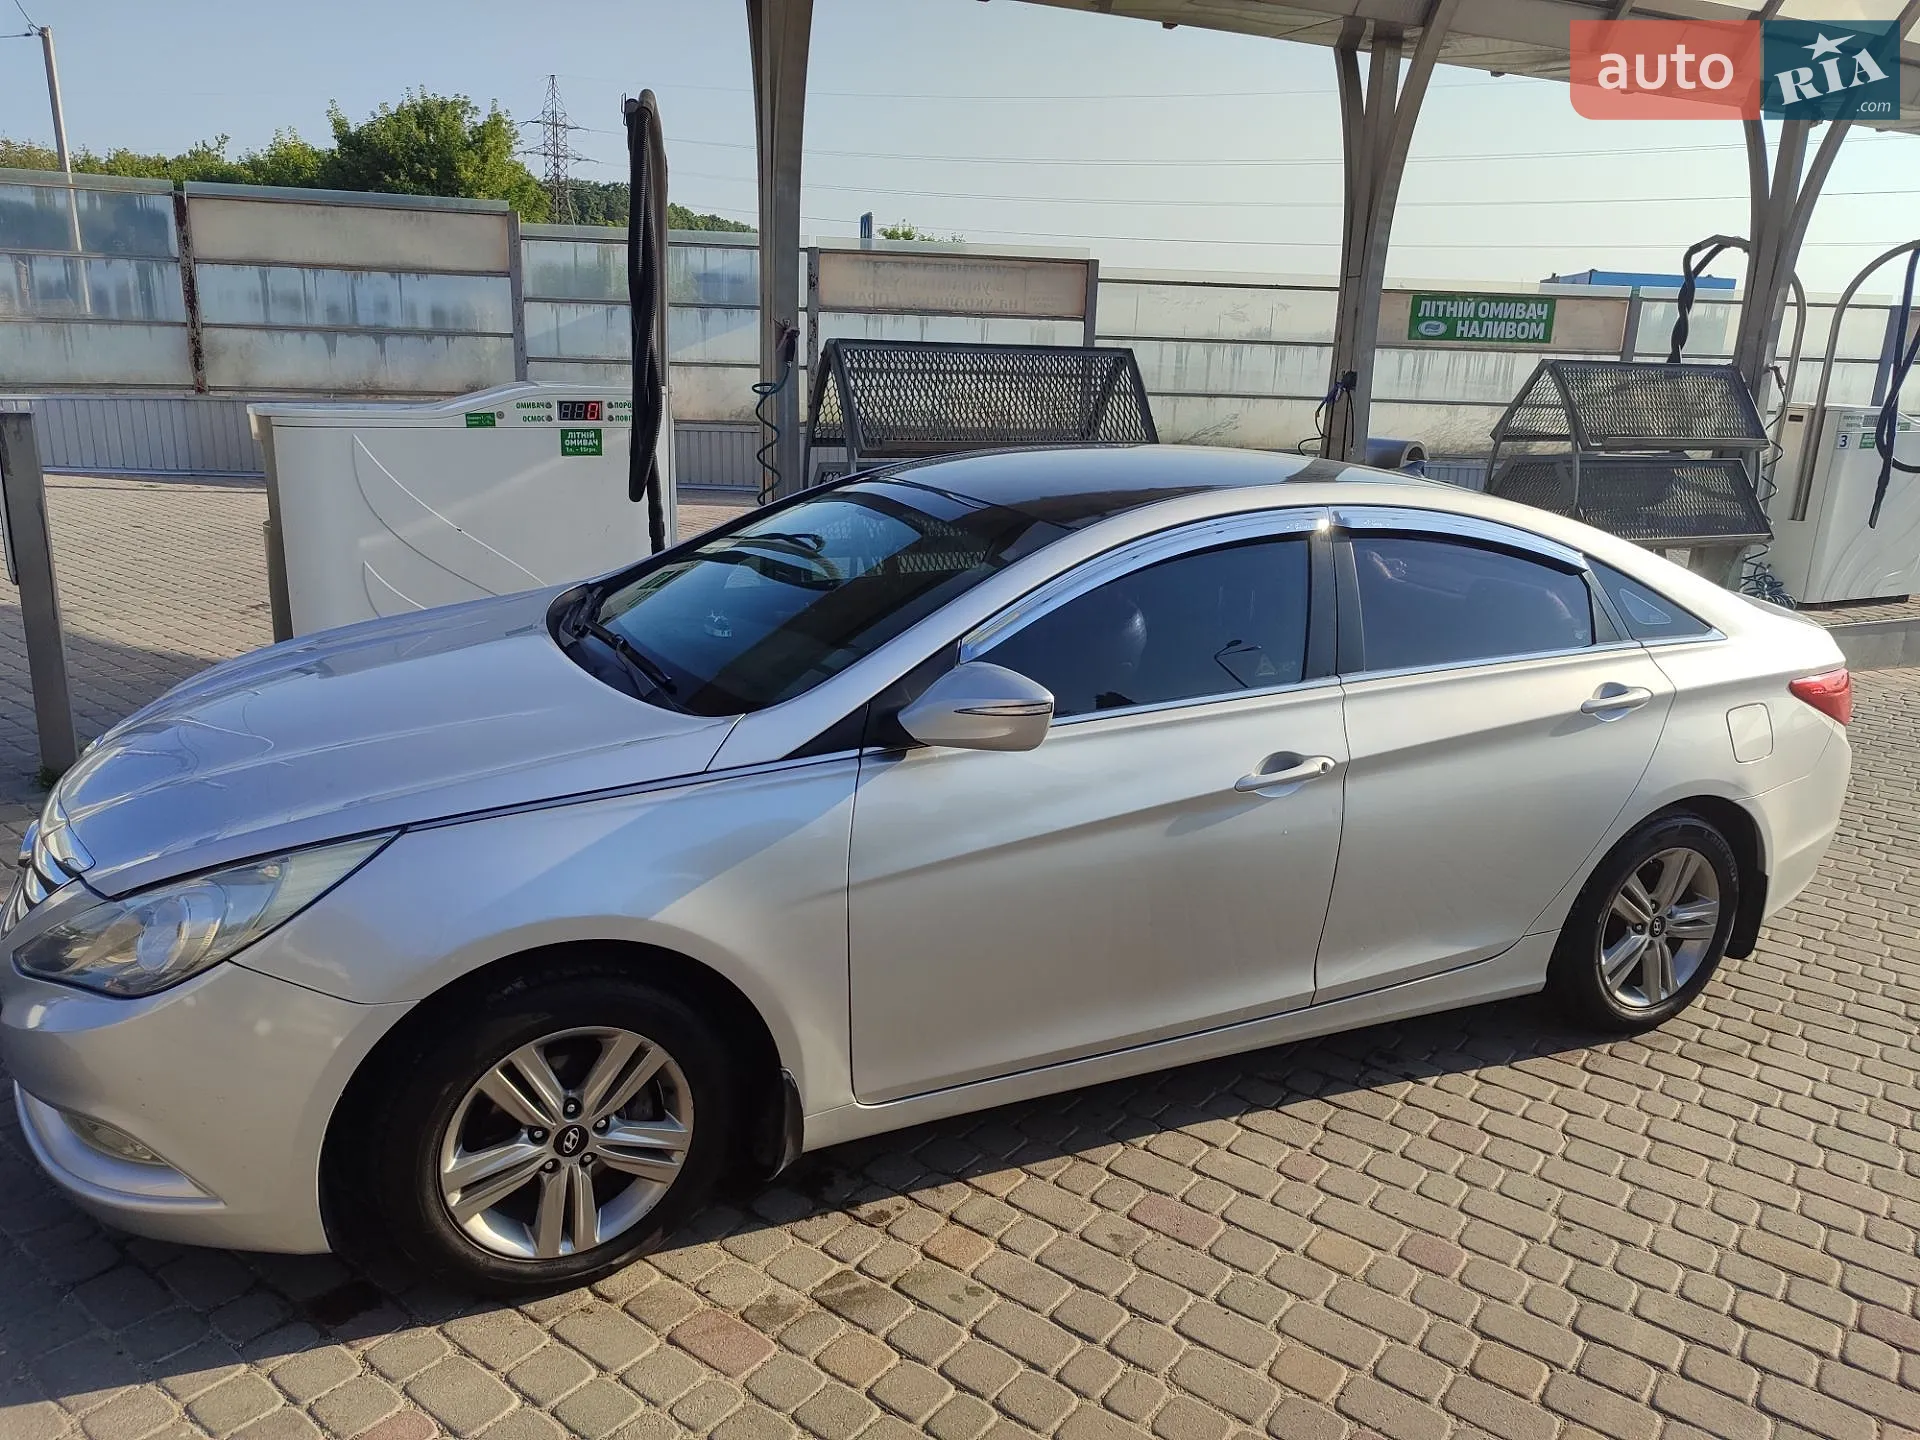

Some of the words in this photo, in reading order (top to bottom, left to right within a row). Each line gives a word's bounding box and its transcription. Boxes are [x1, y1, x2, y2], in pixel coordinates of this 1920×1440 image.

[1418, 298, 1475, 318] ЛІТНІЙ
[1477, 302, 1549, 320] ОМИВАЧ
[1455, 320, 1545, 340] НАЛИВОМ
[567, 430, 595, 439] ЛІТНІЙ
[1839, 435, 1848, 448] 3
